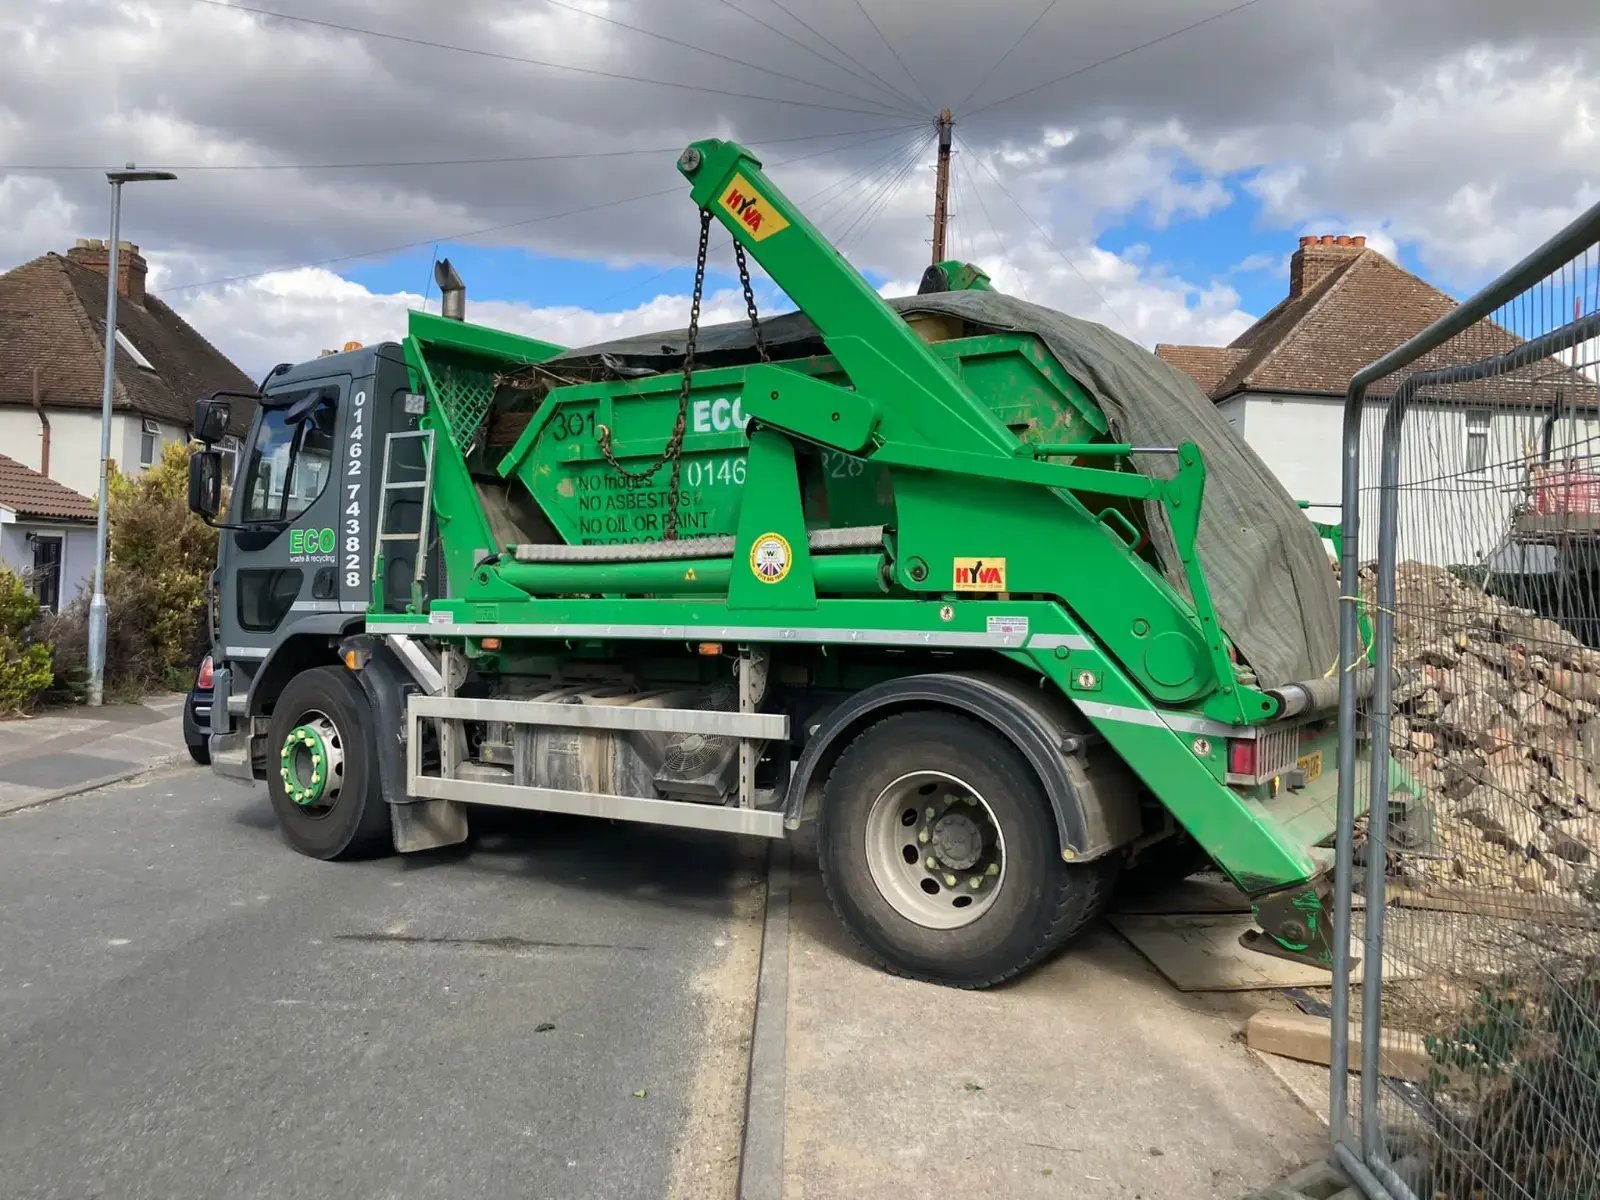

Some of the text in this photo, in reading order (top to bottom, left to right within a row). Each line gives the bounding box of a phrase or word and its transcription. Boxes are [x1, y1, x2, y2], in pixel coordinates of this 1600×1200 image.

[726, 188, 762, 233] HYVA
[552, 409, 595, 442] 301
[345, 391, 366, 587] 01462 743828
[579, 474, 601, 491] NO
[579, 490, 691, 511] NO ASBESTOS
[580, 511, 709, 534] NO OIL OR PAINT
[290, 528, 336, 554] ECO
[956, 560, 1002, 584] HYVA
